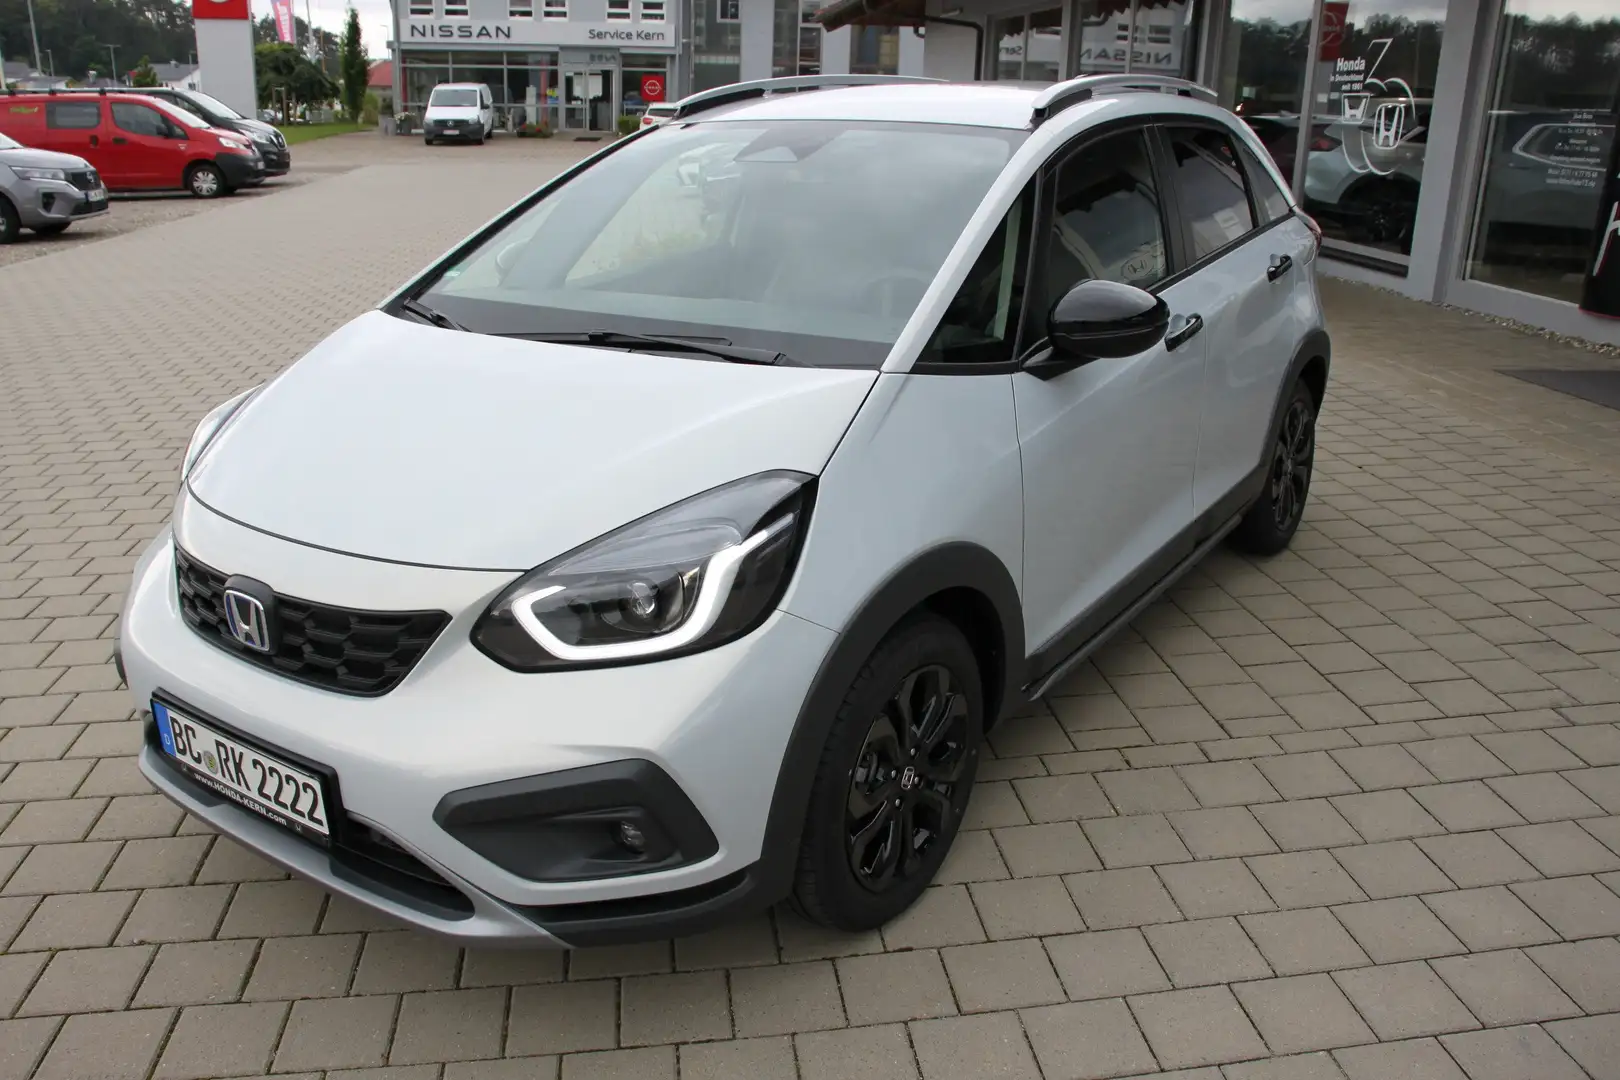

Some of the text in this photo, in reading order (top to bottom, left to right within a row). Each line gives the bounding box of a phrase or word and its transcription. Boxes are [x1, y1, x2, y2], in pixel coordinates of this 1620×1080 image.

[410, 24, 511, 39] NISSAN
[588, 28, 665, 41] Service Kern
[1336, 56, 1366, 72] Honda
[169, 715, 324, 827] BC RK 2222
[194, 772, 287, 826] www.HONDA-KERN.com
